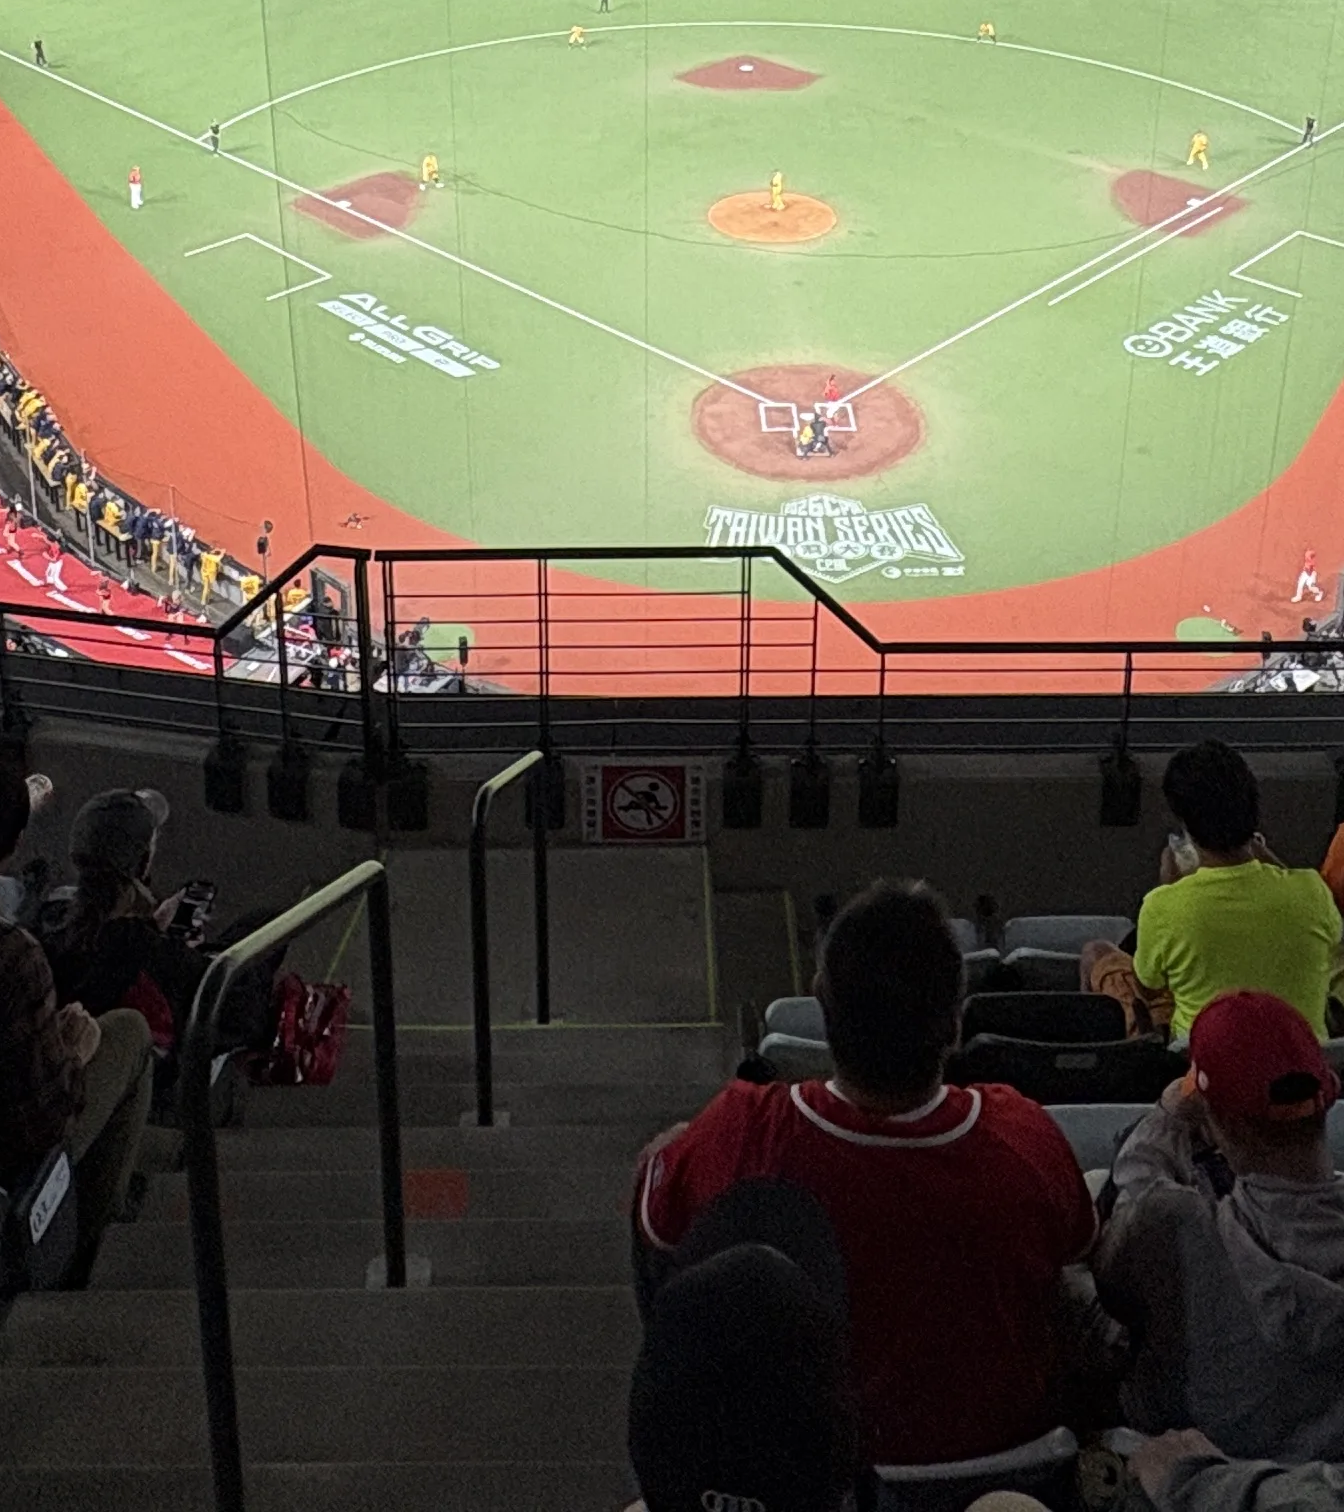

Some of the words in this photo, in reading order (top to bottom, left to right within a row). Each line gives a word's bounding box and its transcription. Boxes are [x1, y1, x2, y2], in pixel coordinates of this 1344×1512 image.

[1168, 303, 1289, 376] 王道銀行
[708, 508, 827, 547] TAIWAN
[833, 506, 962, 559] SERIES
